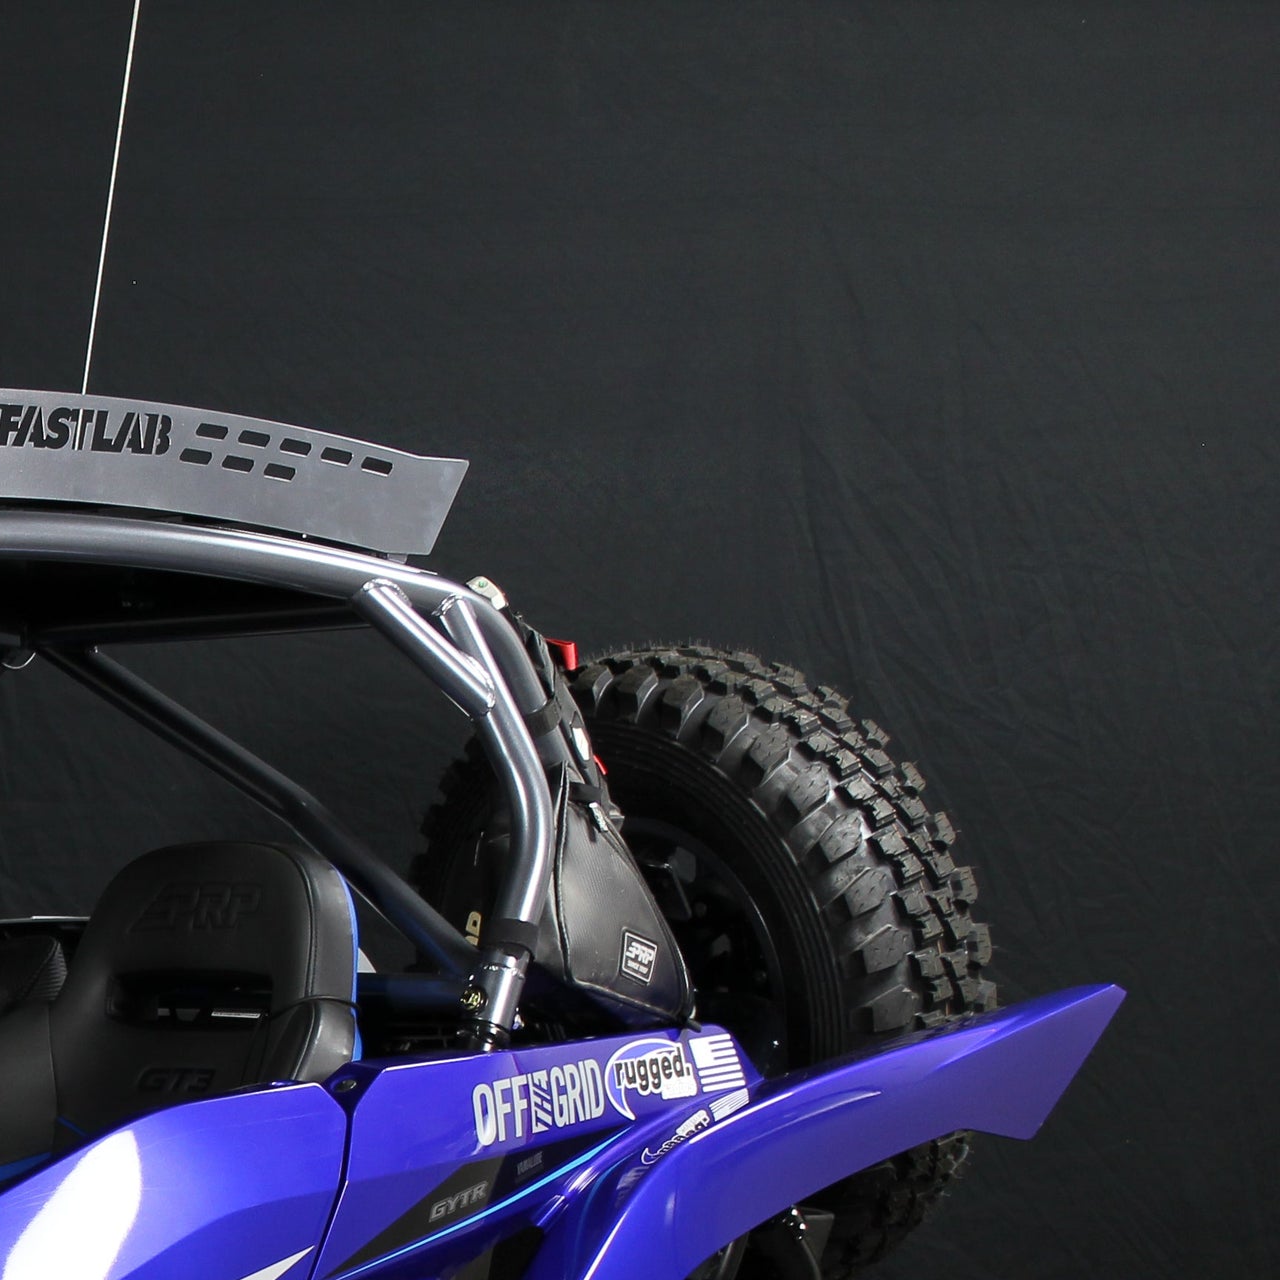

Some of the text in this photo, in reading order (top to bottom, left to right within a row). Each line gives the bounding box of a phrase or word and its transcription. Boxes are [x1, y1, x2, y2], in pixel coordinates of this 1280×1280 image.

[472, 1073, 528, 1146] OFF
[549, 1058, 605, 1128] GRID
[429, 1181, 487, 1222] GYTR
